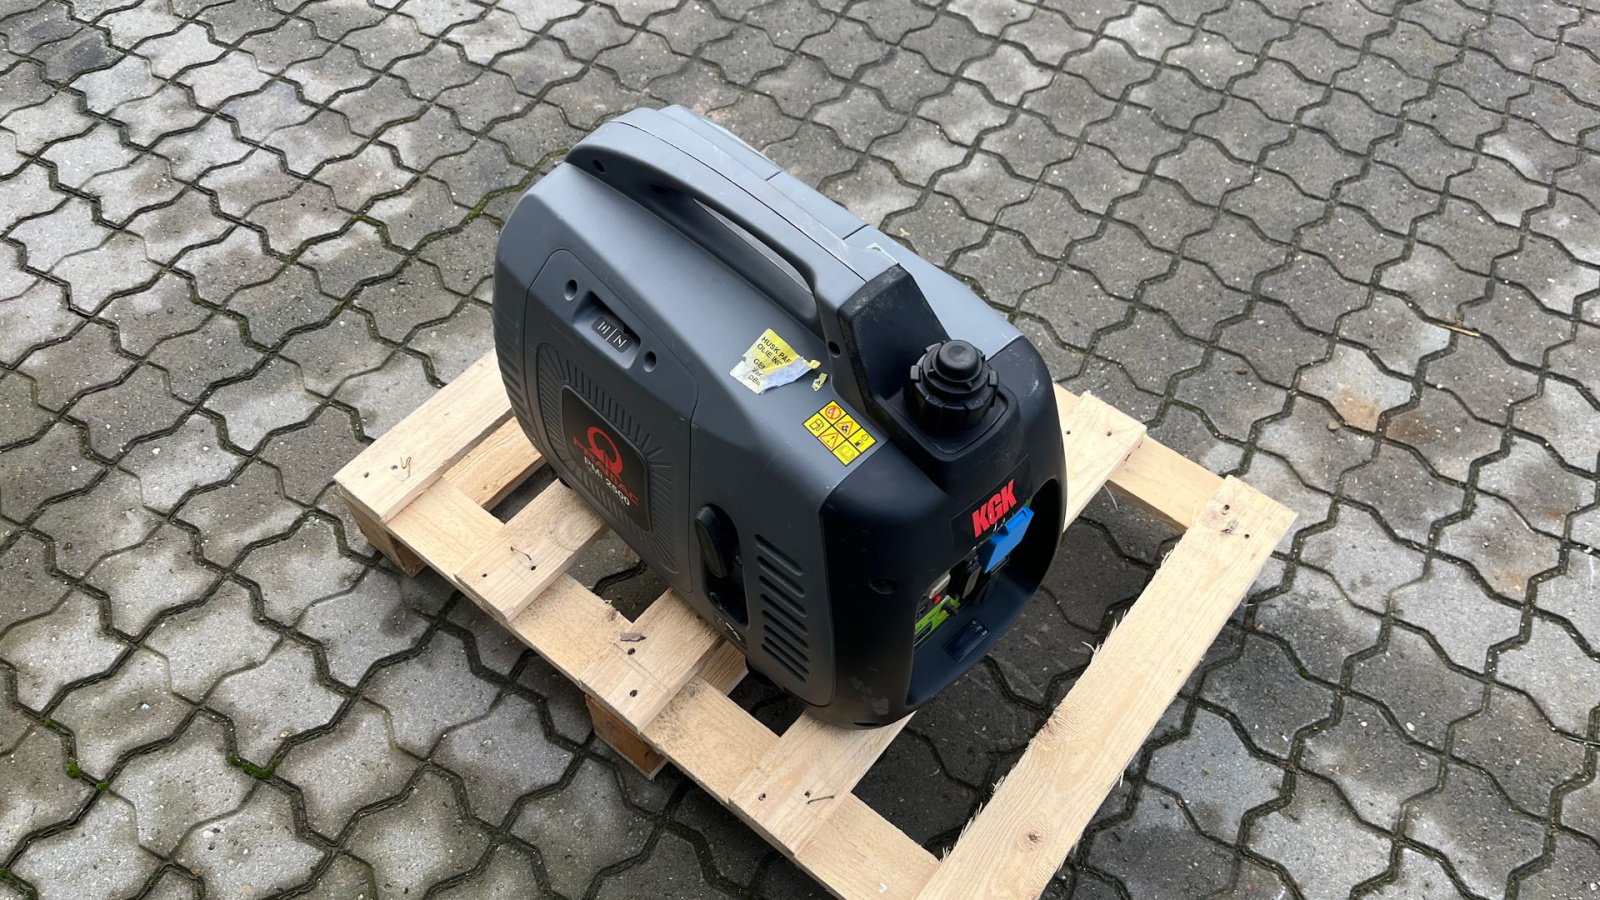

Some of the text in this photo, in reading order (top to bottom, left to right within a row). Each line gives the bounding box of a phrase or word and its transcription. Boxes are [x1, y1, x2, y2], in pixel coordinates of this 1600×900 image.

[757, 343, 772, 358] OLIE
[761, 336, 781, 354] HUSK
[972, 479, 1017, 538] KGK
